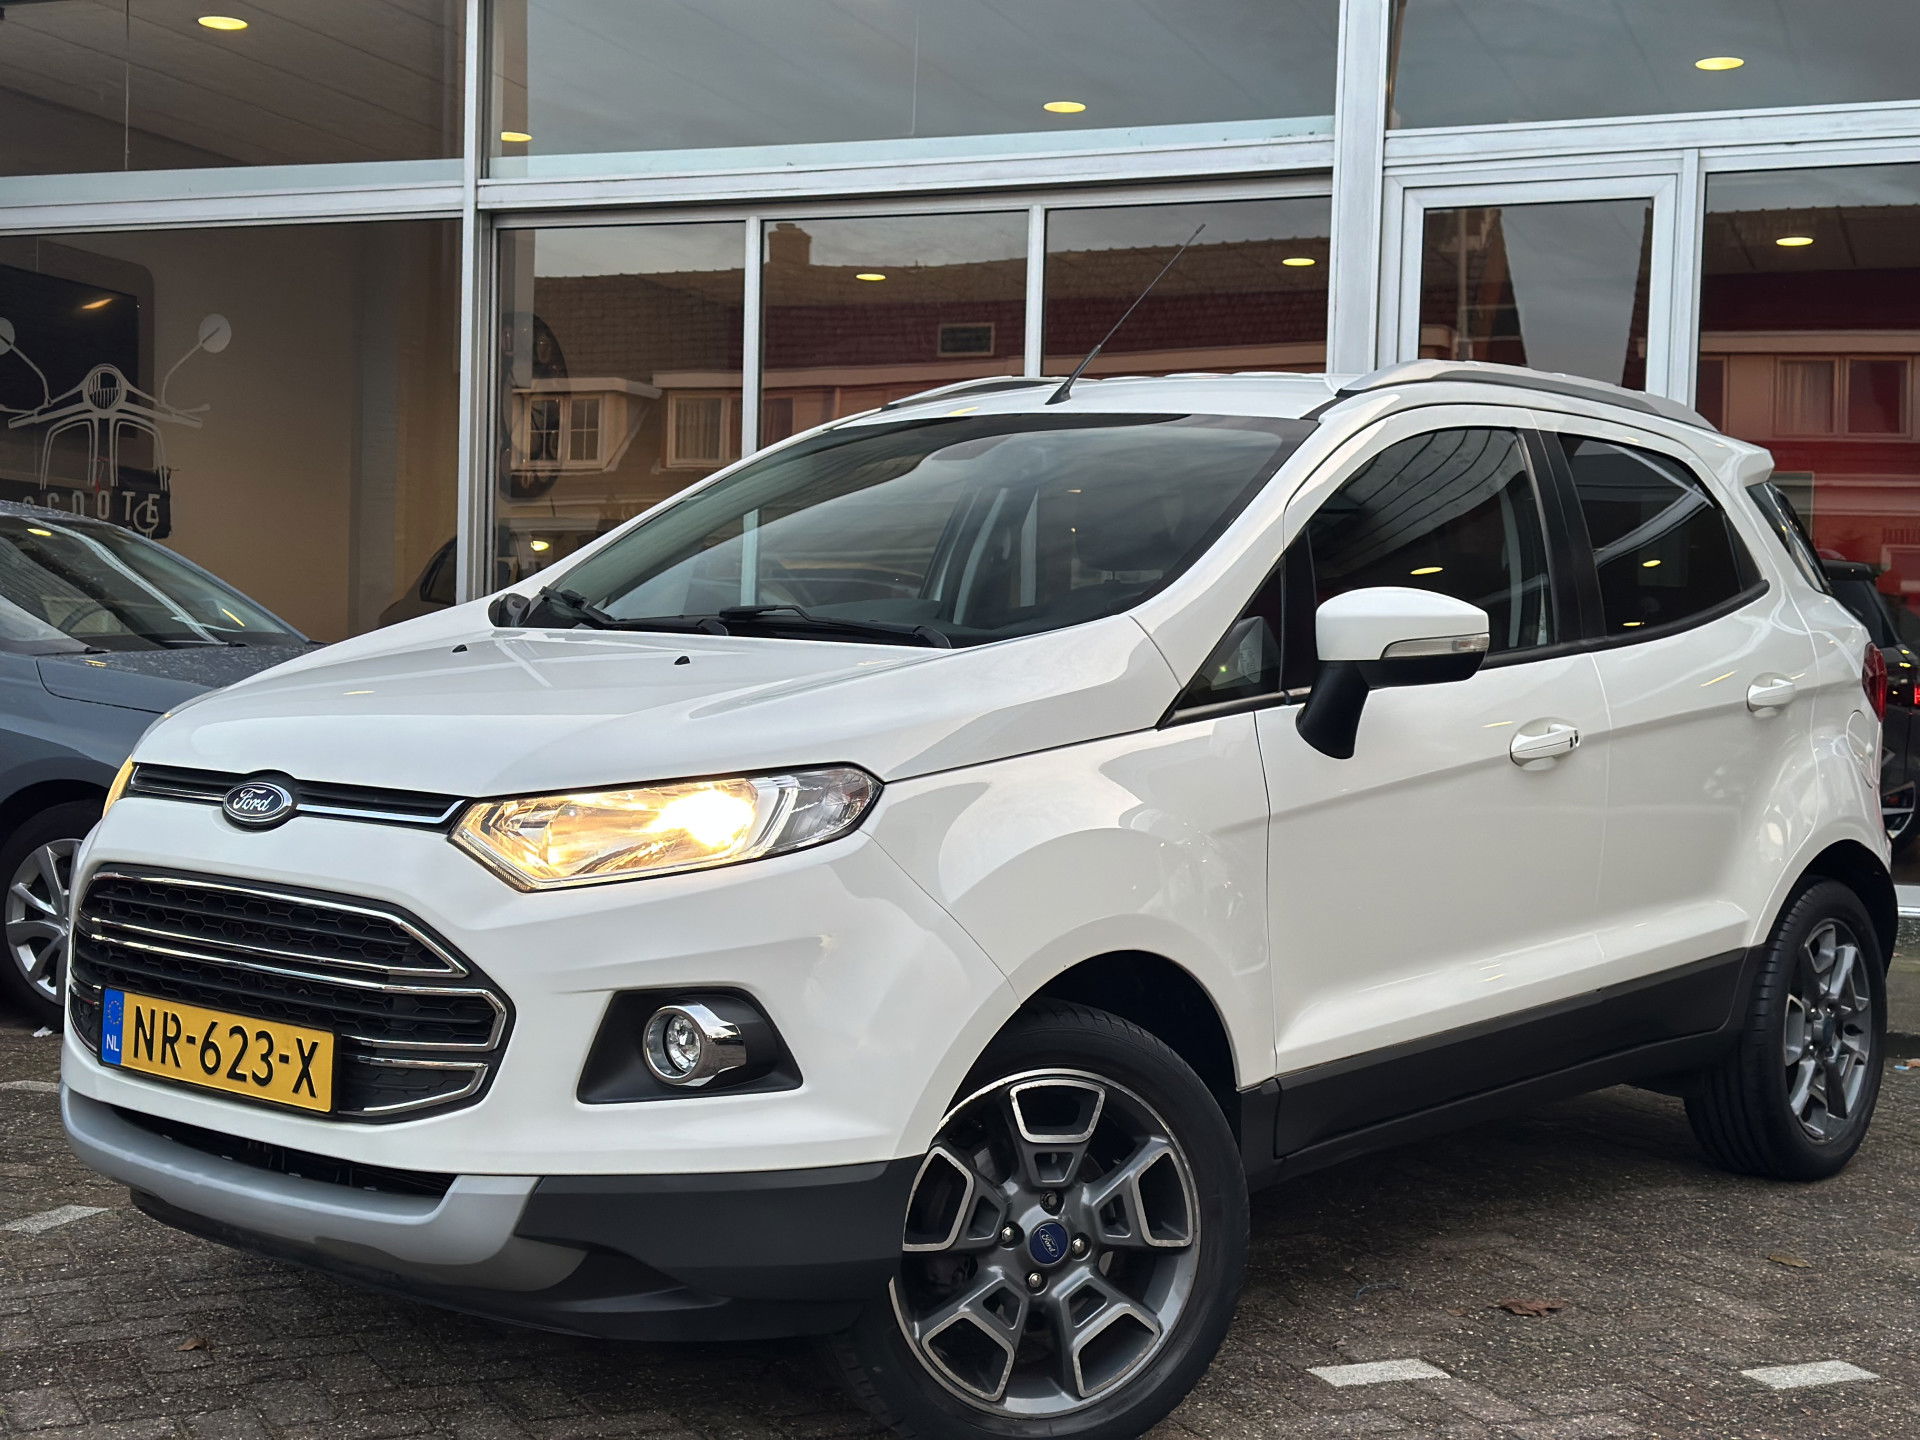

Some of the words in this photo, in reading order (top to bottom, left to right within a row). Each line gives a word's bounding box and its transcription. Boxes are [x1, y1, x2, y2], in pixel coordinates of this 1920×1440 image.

[233, 788, 274, 811] Ford
[106, 1033, 120, 1052] NL
[133, 1005, 319, 1098] NR-623-X
[1041, 1234, 1056, 1252] Ford
